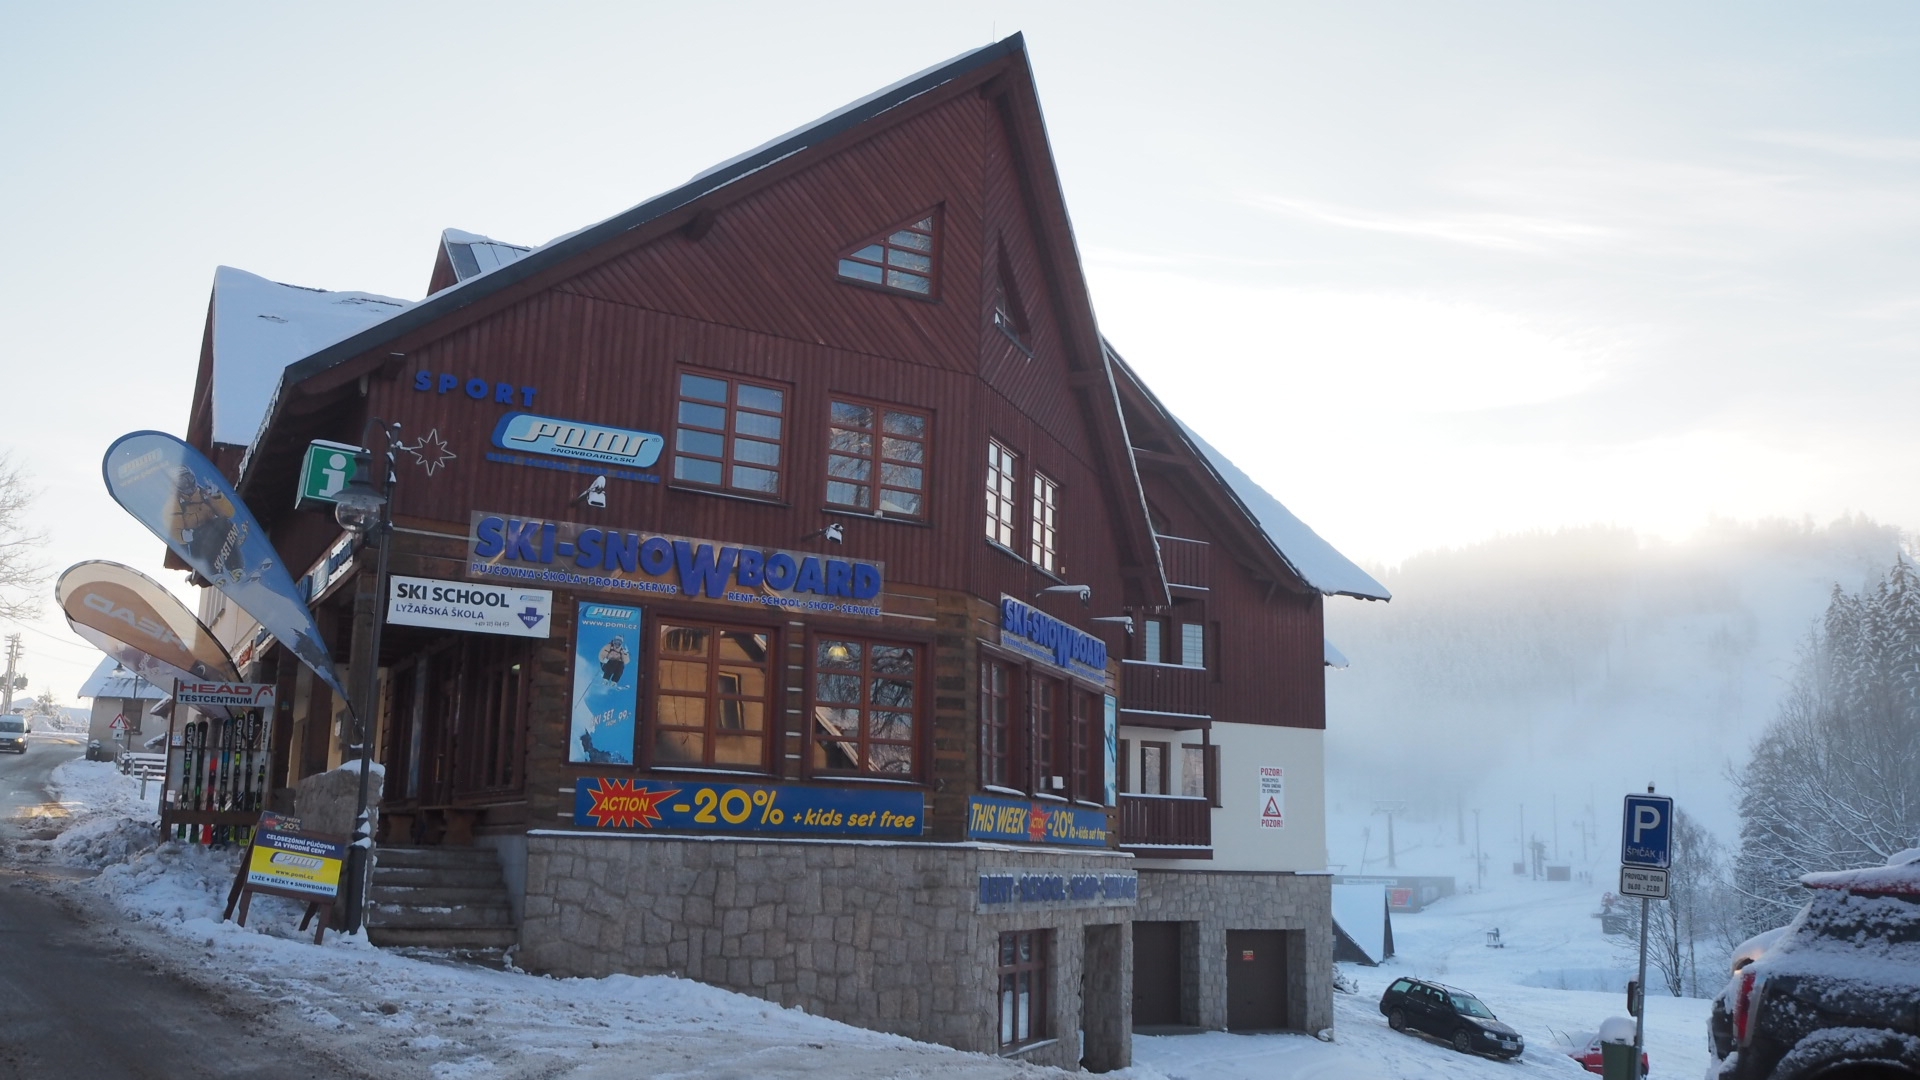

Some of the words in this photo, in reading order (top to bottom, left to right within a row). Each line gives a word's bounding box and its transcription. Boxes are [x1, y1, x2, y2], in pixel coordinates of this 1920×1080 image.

[414, 370, 537, 407] SPORT
[550, 447, 613, 461] SNOWBOARD
[221, 541, 231, 560] SET
[474, 516, 881, 600] SKI-SNOWBOARD
[542, 567, 581, 584] ŠKOLA
[587, 577, 633, 589] PRODEJ
[638, 582, 677, 594] SERVIS
[396, 582, 427, 601] SKI
[432, 586, 509, 608] SCHOOL
[396, 603, 448, 617] LYŽAŘSKÁ
[451, 607, 484, 620] ŠKOLA
[728, 592, 754, 603] RENT
[761, 596, 801, 608] SCHOOL
[808, 601, 835, 611] SHOP
[841, 604, 880, 616] SERVICE
[582, 619, 638, 630] www.pomi.cz
[1003, 598, 1107, 670] SKI-SNOWBOARD
[180, 682, 253, 695] HEAD
[179, 694, 252, 704] TESTCENTRUM
[603, 708, 614, 723] SET
[186, 726, 194, 760] HEAD
[235, 719, 243, 751] HEAD
[1260, 767, 1282, 776] POZOR!
[599, 796, 649, 813] ACTION
[672, 788, 785, 825] -20%
[847, 811, 877, 828] set
[879, 810, 916, 828] free
[970, 803, 997, 832] THIS
[996, 806, 1028, 834] WEEK
[1047, 810, 1075, 839] -20%
[1096, 827, 1106, 841] free
[1261, 819, 1283, 828] POZOR!
[1633, 805, 1661, 843] P
[266, 833, 306, 845] CELOSEZÓNNÍ
[306, 839, 336, 851] PŮJČOVNA
[310, 846, 326, 855] CENY
[1626, 845, 1656, 859] ŠPIČÁK
[275, 870, 314, 880] www.pomi.cz
[1624, 872, 1649, 882] PROVOZNÍ
[1650, 874, 1664, 883] DOBA
[270, 877, 289, 886] BĚŽKY
[294, 881, 335, 893] SNOWBOARDY
